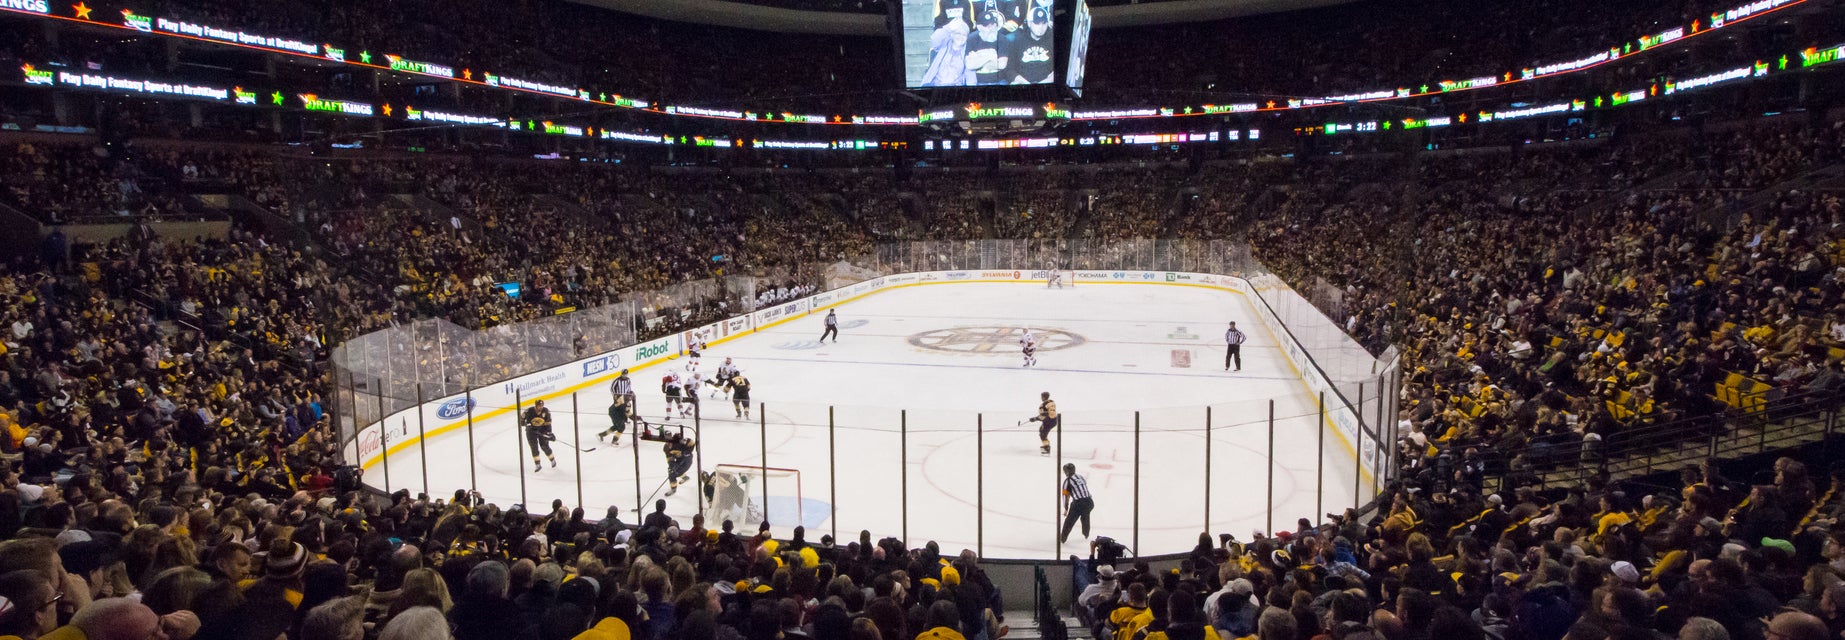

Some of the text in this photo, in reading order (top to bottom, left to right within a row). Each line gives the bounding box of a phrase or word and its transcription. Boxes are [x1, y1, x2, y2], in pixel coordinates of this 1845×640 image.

[158, 18, 178, 32] Play
[180, 22, 202, 36] Daily
[204, 26, 238, 42] Fantasy
[238, 32, 266, 45] Sports
[266, 38, 276, 46] at
[390, 59, 453, 78] DRAFTKINGS
[60, 72, 81, 86] Play
[83, 74, 106, 88] Daily
[108, 76, 143, 92] Fantasy
[144, 80, 172, 93] Sports
[174, 85, 183, 94] at
[1443, 76, 1497, 92] DRAFTKINGS
[306, 99, 373, 114] DRAFTKINGS
[968, 107, 1033, 118] DRAFTKINGS
[1205, 104, 1258, 114] DRAFTKINGS
[1356, 122, 1376, 132] 3:22
[636, 340, 669, 361] iRobot
[547, 372, 566, 383] Health
[445, 400, 468, 416] Ford
